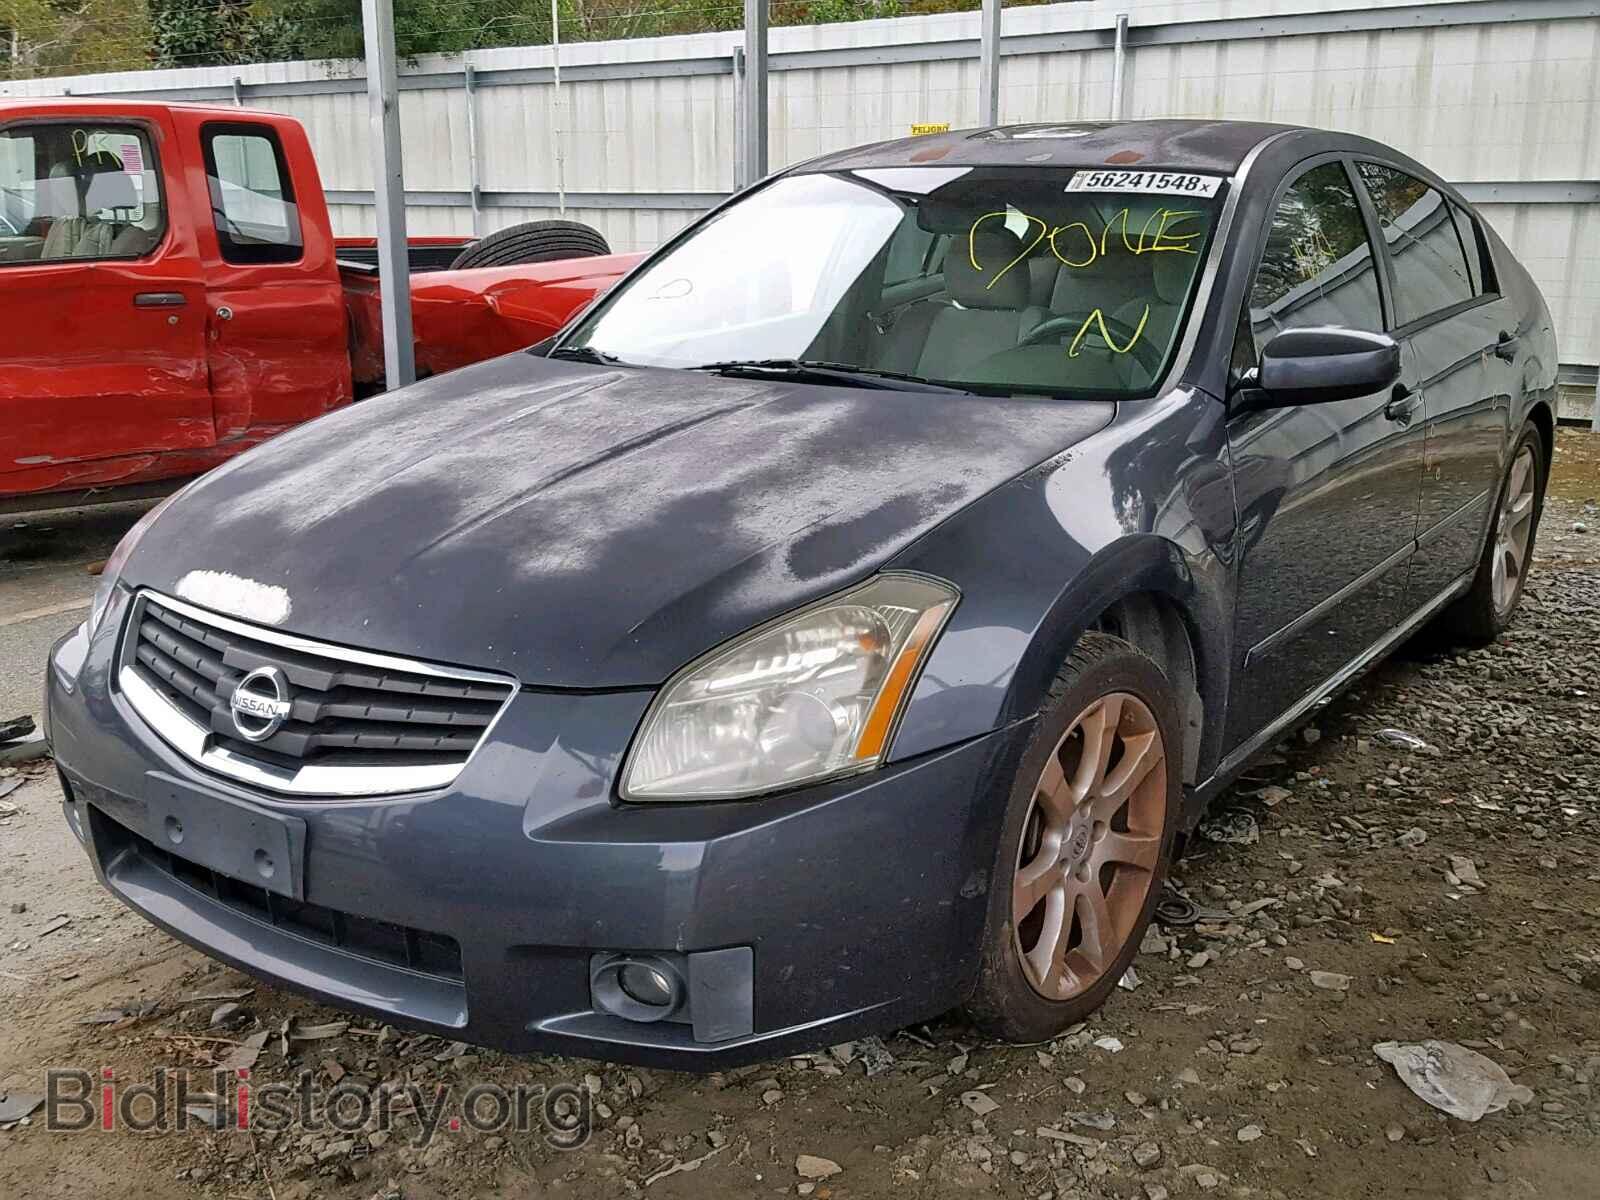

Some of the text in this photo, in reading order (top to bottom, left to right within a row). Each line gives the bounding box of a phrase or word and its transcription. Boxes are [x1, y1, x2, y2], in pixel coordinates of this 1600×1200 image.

[969, 208, 1204, 290] DONE
[1068, 303, 1150, 358] N
[233, 695, 279, 715] NISSAN
